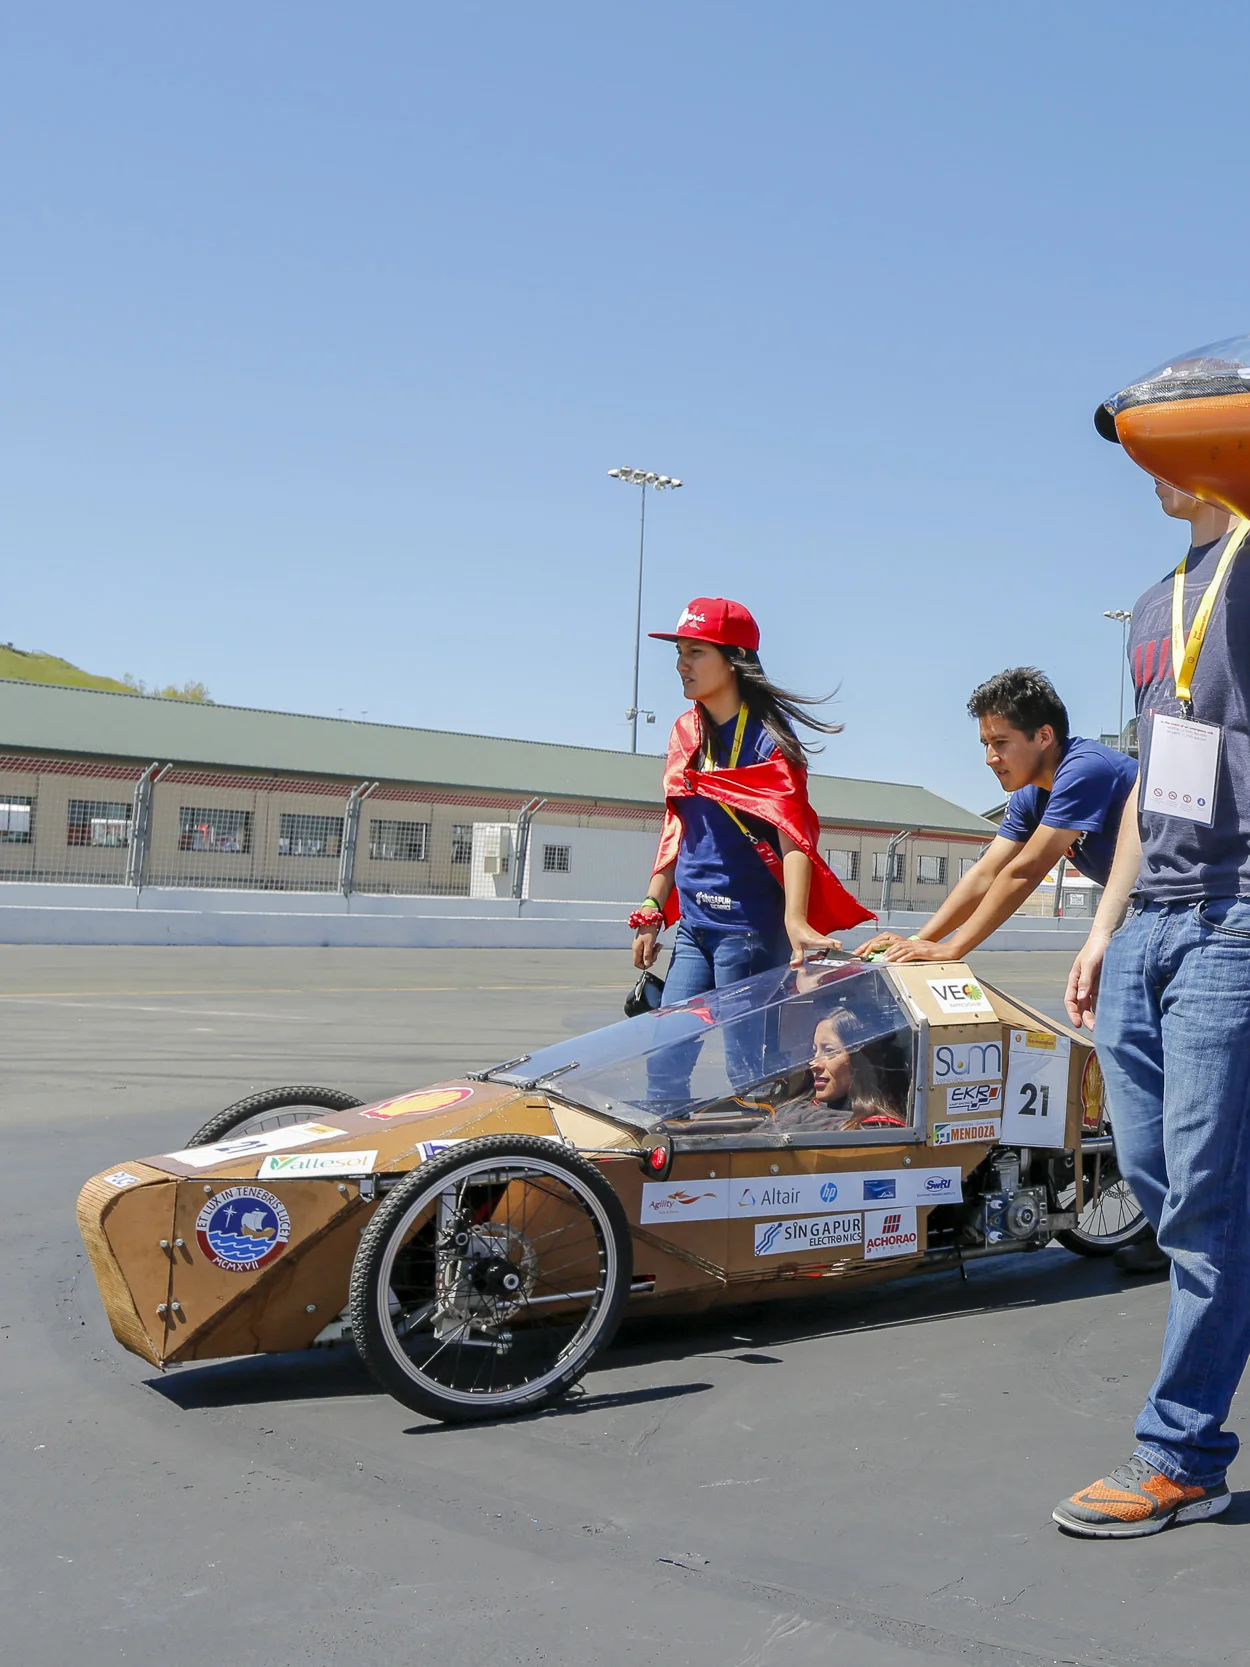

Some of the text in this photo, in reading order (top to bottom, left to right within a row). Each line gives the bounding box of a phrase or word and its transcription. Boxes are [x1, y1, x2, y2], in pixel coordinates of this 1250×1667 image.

[951, 1085, 991, 1101] EKR
[1018, 1083, 1050, 1117] 21
[951, 1125, 995, 1141] MENDOZA
[822, 1182, 838, 1203] hp
[926, 1179, 952, 1190] SwRI
[761, 1187, 800, 1206] Altair
[197, 1216, 208, 1229] ET
[204, 1198, 223, 1217] LUX
[221, 1190, 233, 1201] IN
[236, 1186, 282, 1211] TENEBRIS
[649, 1200, 674, 1211] Agility
[784, 1218, 861, 1240] SINGAPUR
[809, 1232, 862, 1247] ELECTRONICS
[866, 1233, 917, 1249] ACHORAO
[212, 1256, 259, 1272] MCMXVII
